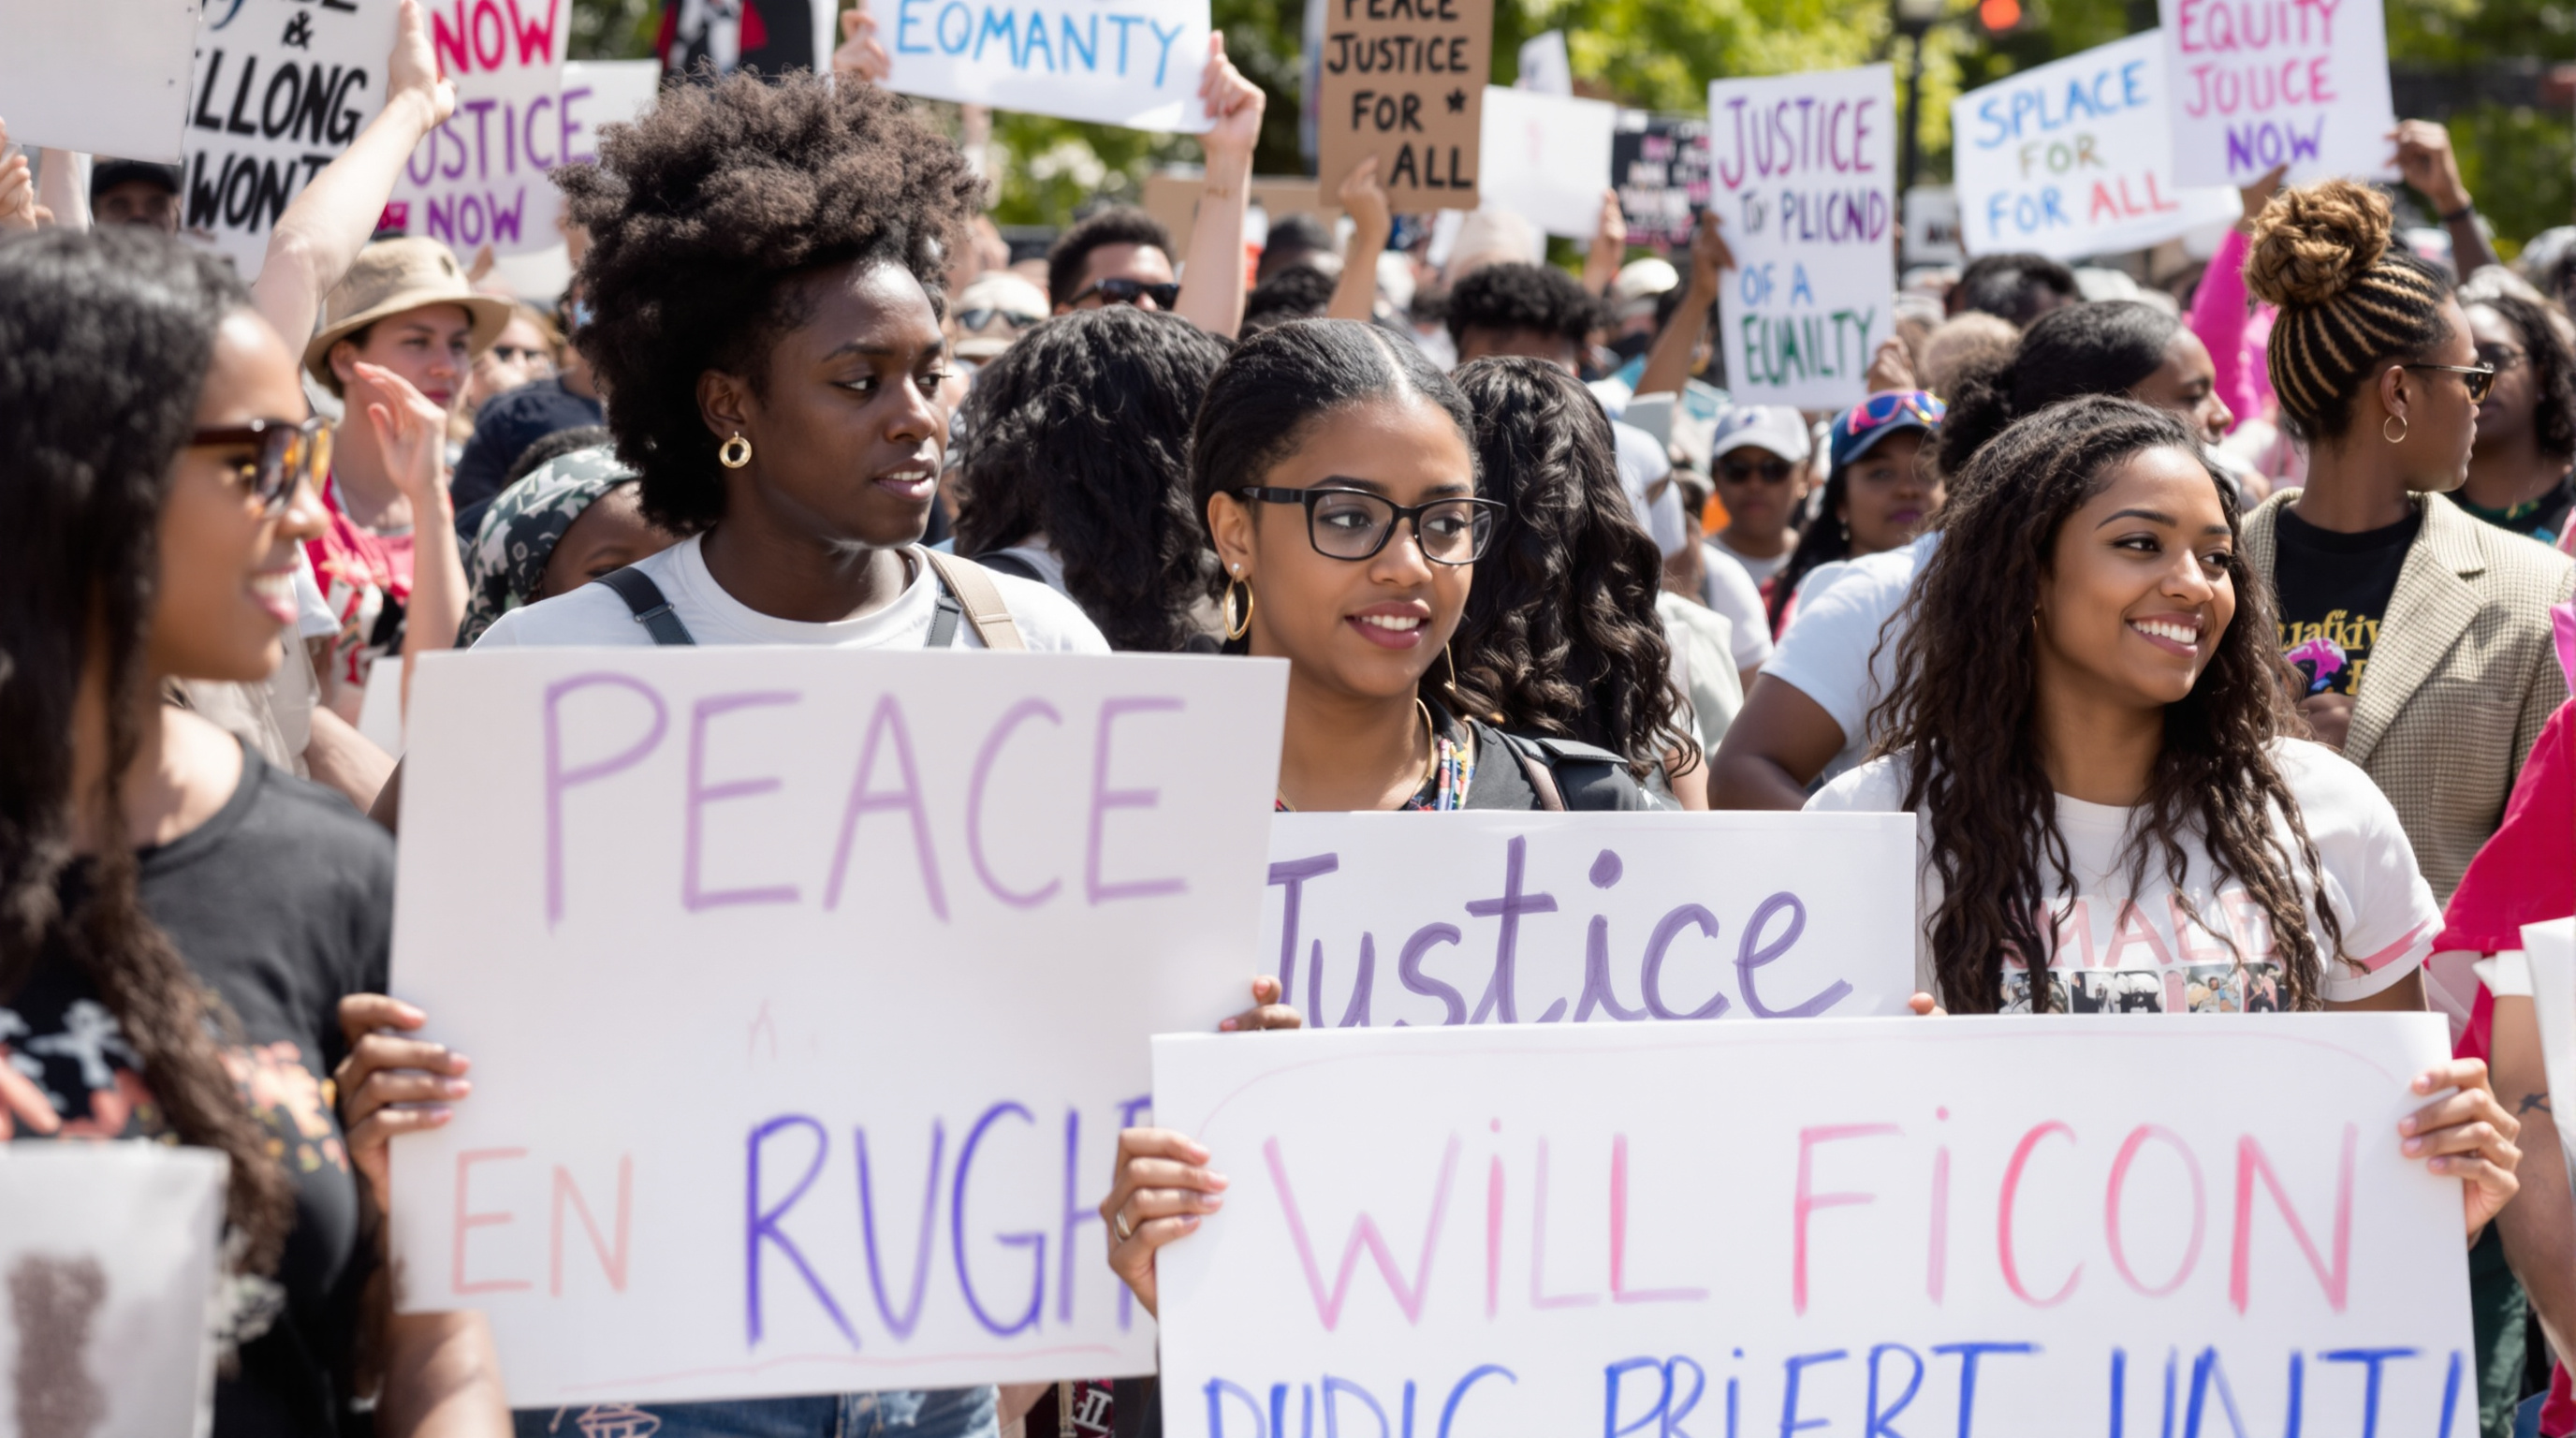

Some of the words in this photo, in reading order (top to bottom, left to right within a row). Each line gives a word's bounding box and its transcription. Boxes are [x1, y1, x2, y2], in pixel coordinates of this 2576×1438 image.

[431, 0, 560, 84] NOW
[1327, 33, 1470, 74] JUSTICE
[186, 49, 368, 144] LLONG
[1351, 91, 1423, 133] FOR
[1975, 60, 2150, 149] SPLACE
[408, 87, 599, 186] USTICE
[1389, 142, 1473, 189] ALL
[1718, 97, 1877, 190] JUSTICE
[2018, 132, 2107, 180] FOR
[2226, 113, 2327, 176] NOW
[427, 187, 524, 246] NOW
[1986, 186, 2071, 237] FOR
[2090, 169, 2182, 226] ALL
[1740, 261, 1775, 307] OF
[1789, 260, 1815, 307] A
[543, 669, 1190, 937] PEACE
[451, 1147, 635, 1299] EN
[744, 1095, 1152, 1352] RUGH
